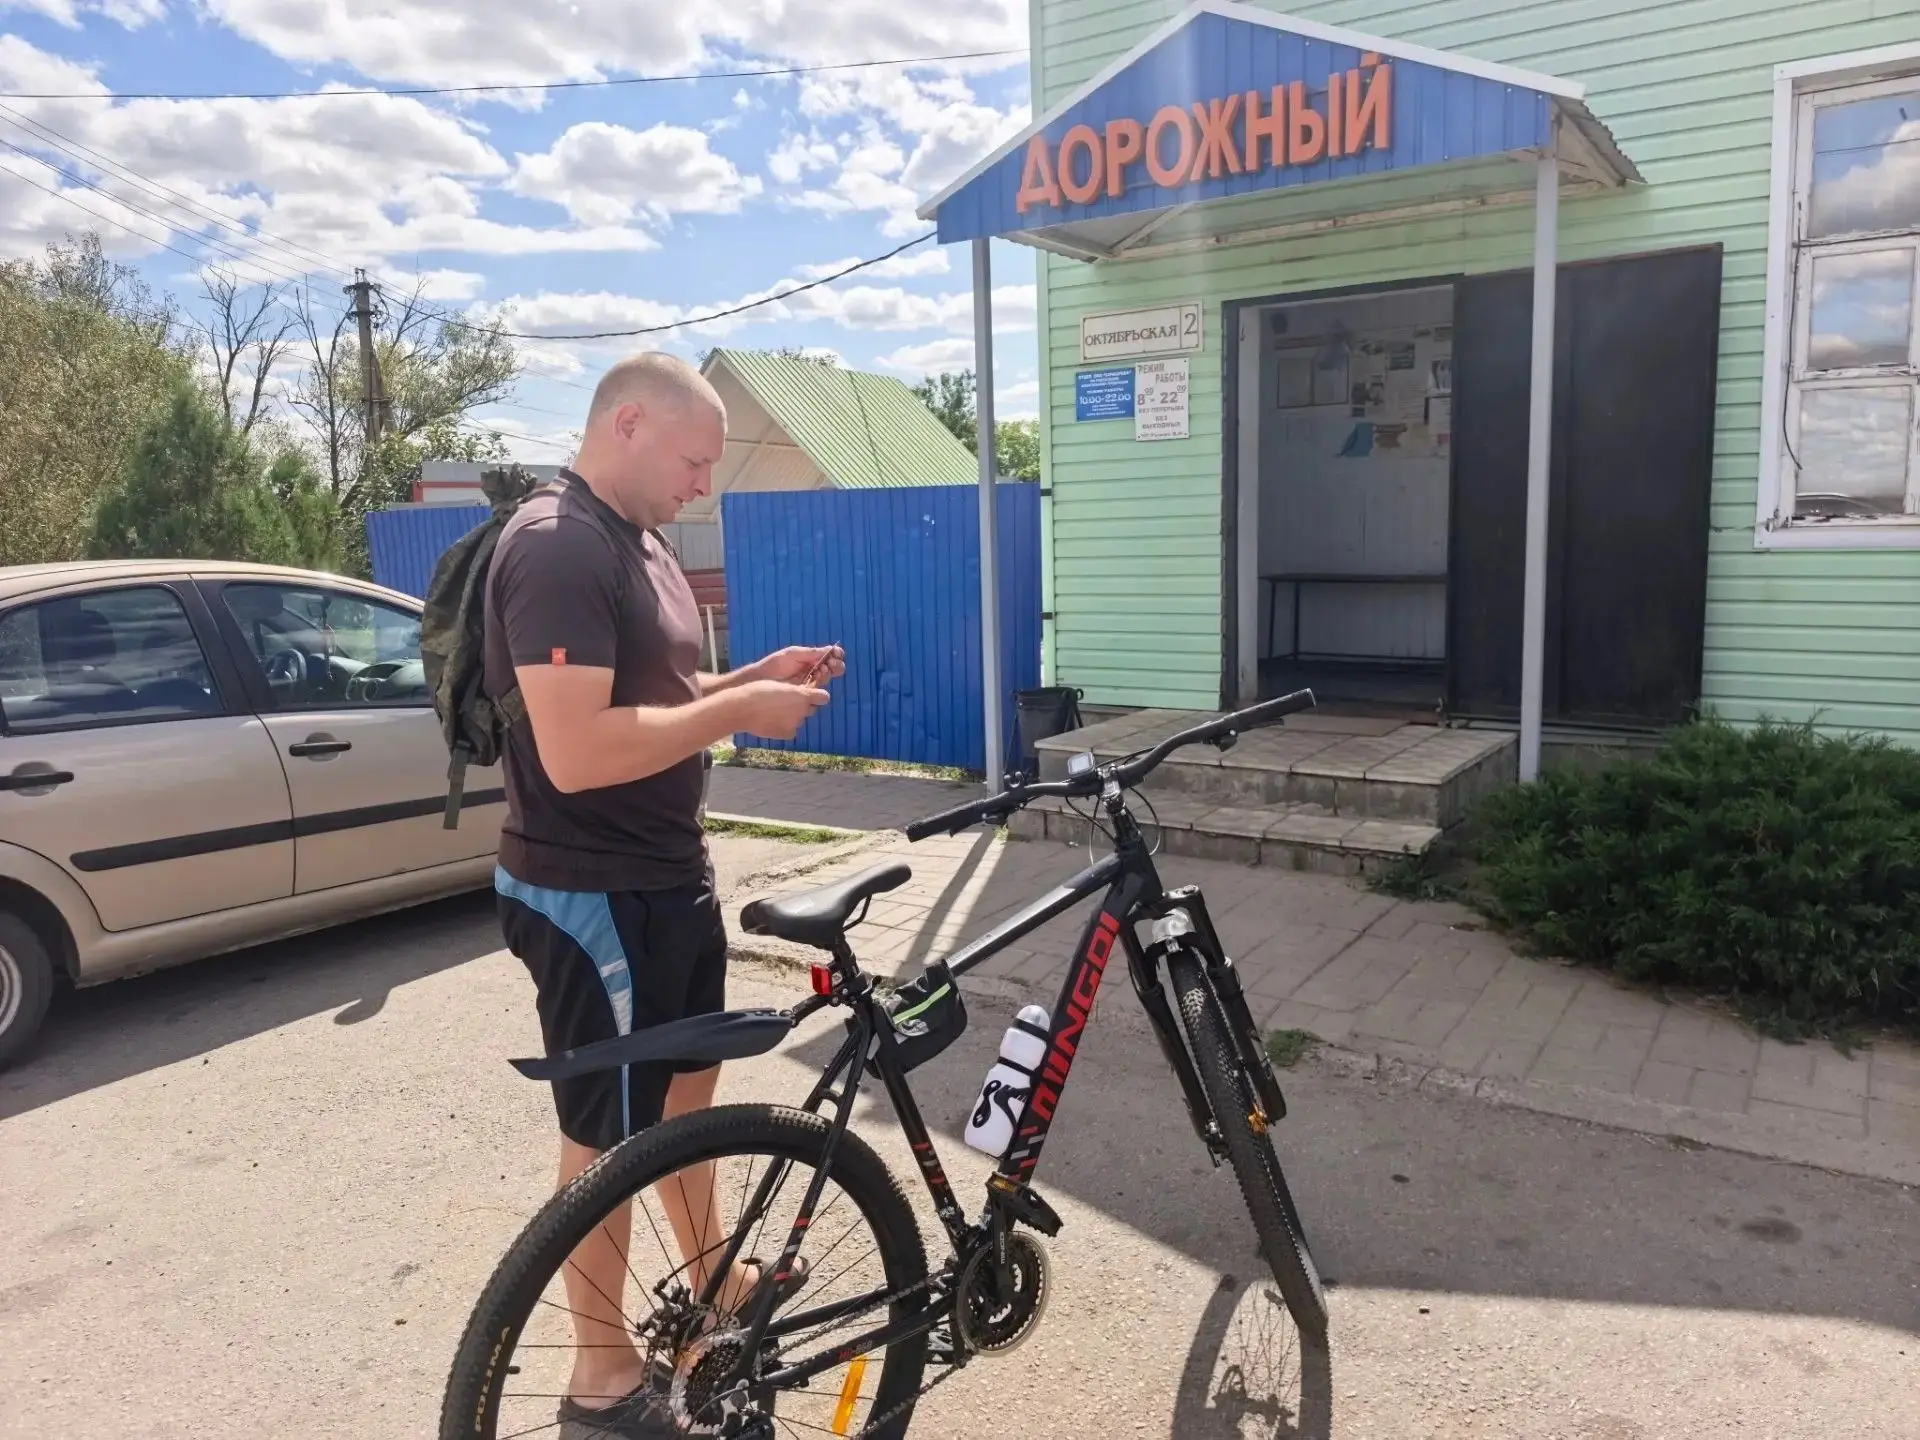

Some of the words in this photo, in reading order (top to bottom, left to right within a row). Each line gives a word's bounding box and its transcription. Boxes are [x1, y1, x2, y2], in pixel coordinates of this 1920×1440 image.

[1016, 52, 1391, 213] ДОРОЖНЫЙ
[1085, 325, 1178, 346] ОКТЯБРЬСКАЯ
[1183, 313, 1197, 336] 2
[1137, 363, 1165, 374] РЕЖИМ
[1155, 372, 1186, 384] РАБОТЫ
